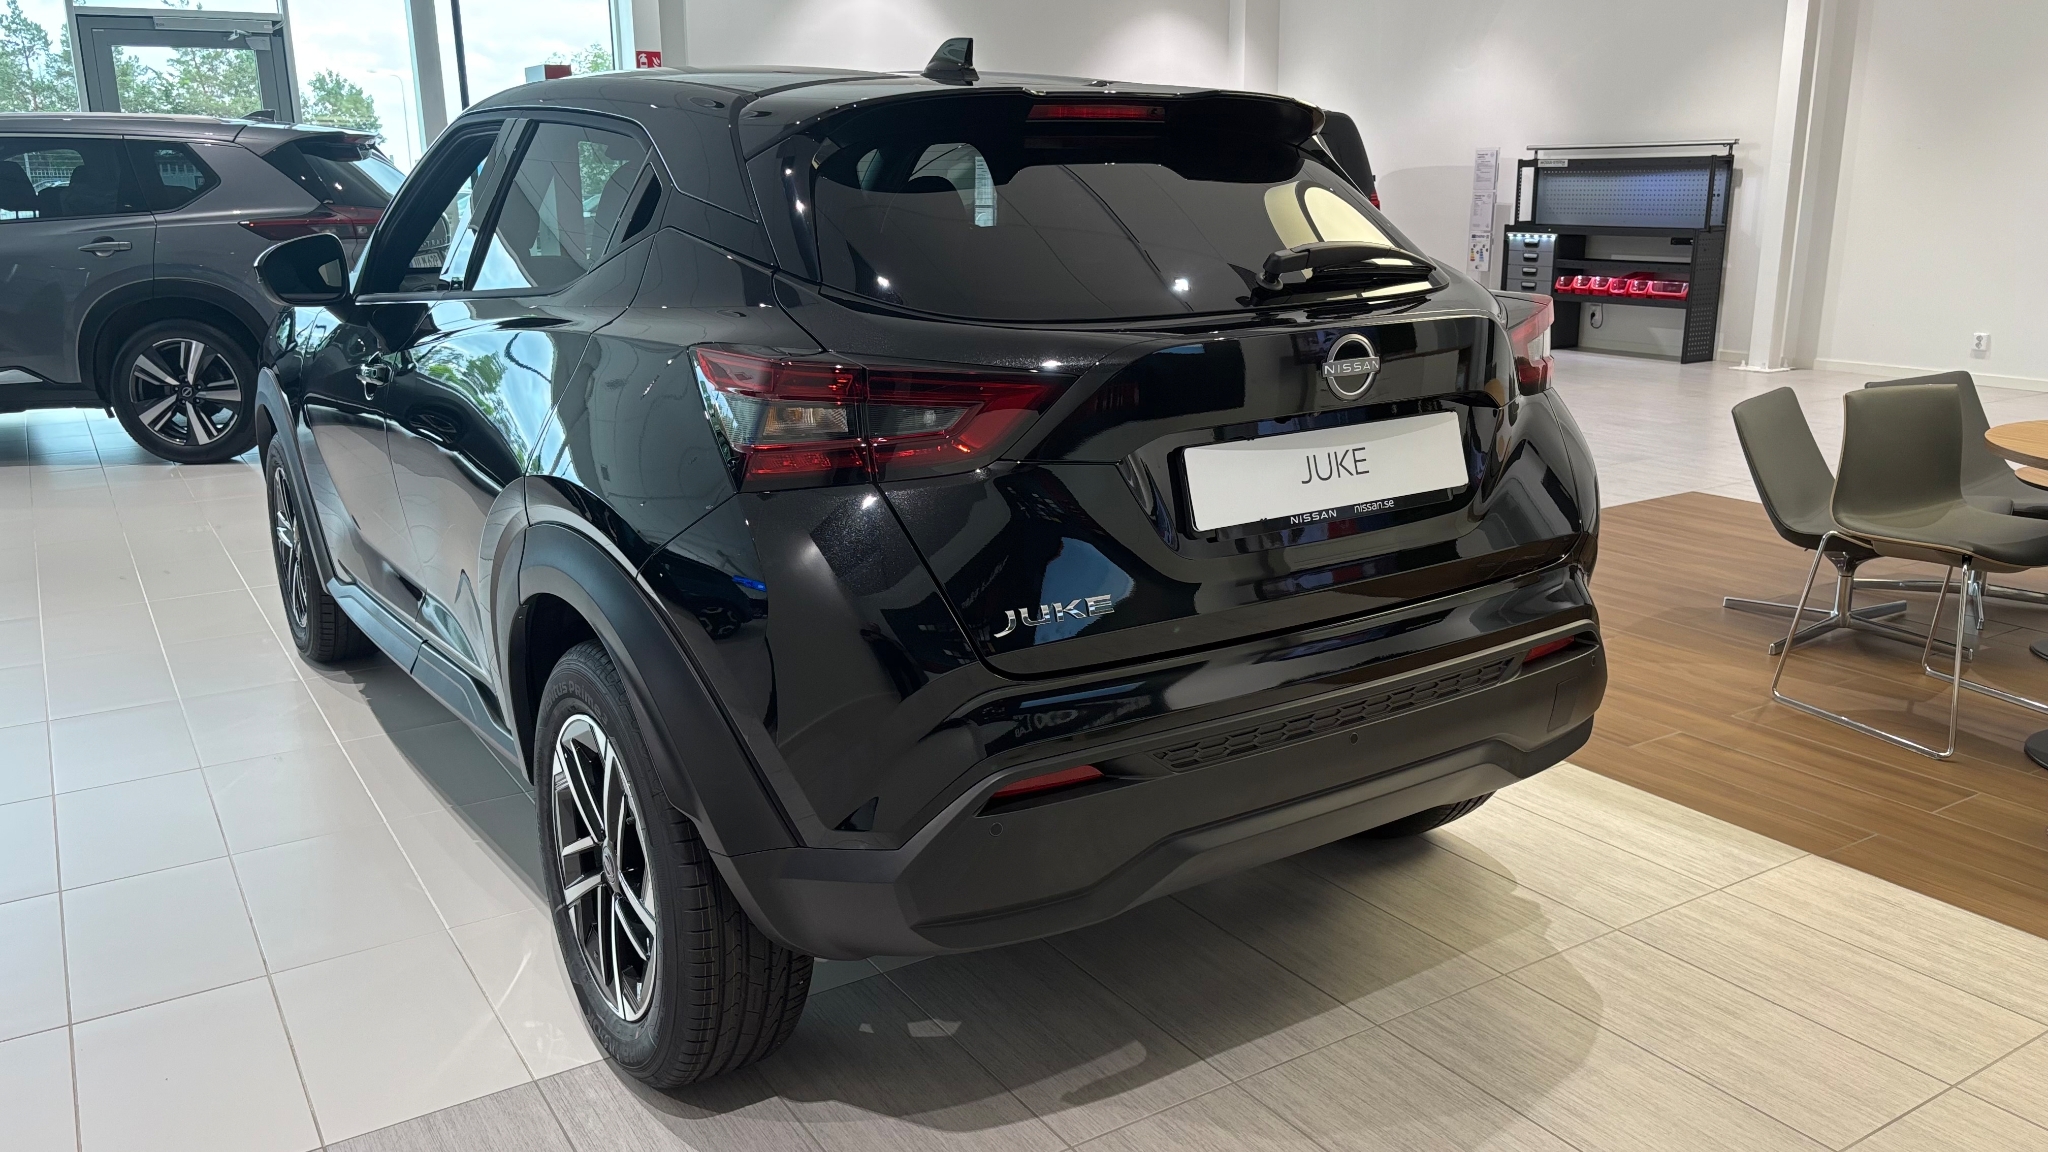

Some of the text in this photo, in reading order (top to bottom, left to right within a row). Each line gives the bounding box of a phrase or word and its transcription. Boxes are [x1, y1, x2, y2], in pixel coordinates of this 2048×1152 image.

[1324, 360, 1379, 375] NISSAN
[1301, 446, 1369, 485] JUKE
[1290, 499, 1395, 525] NISSAN nissan.se
[993, 594, 1115, 638] JUKE
